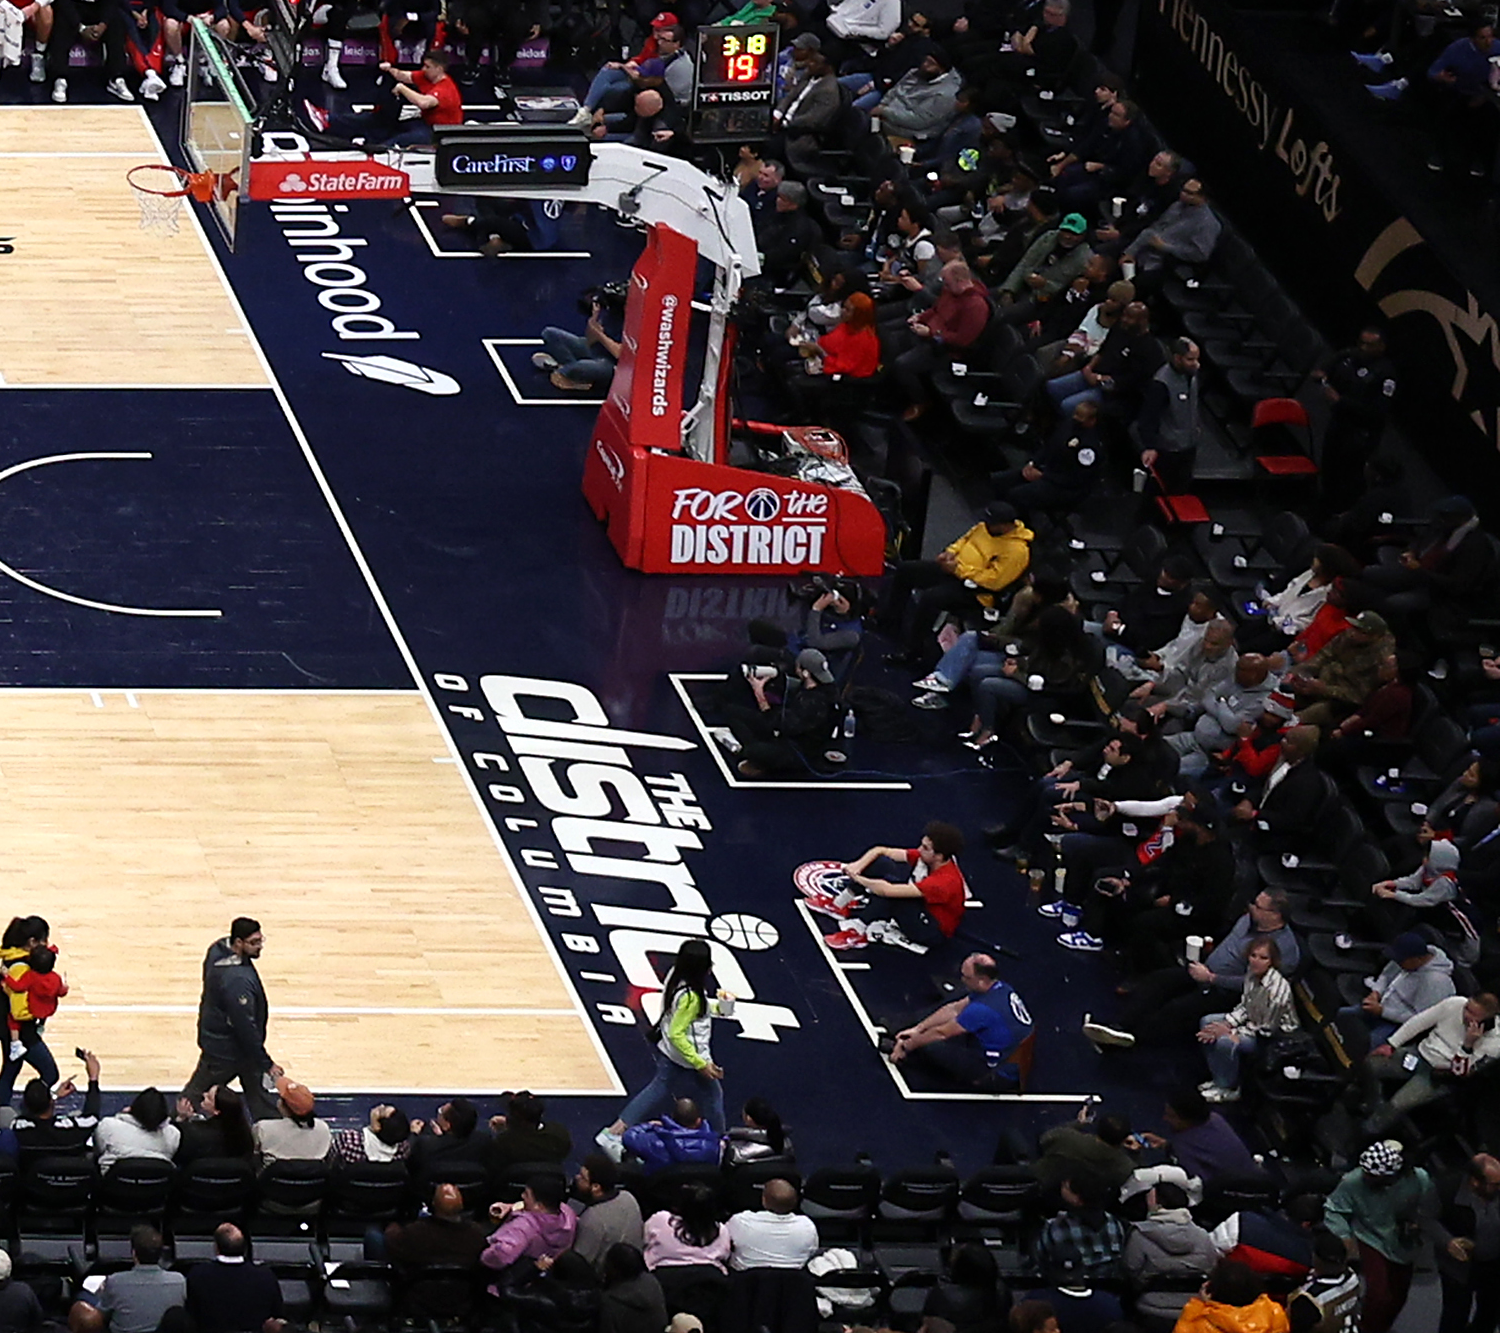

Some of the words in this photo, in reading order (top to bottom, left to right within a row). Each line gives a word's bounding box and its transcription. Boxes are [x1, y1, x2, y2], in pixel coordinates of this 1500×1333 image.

[723, 34, 766, 55] 3:18
[728, 55, 754, 80] 19
[719, 90, 770, 102] TISSOT
[452, 155, 534, 174] CareFirst
[1275, 108, 1342, 223] Lofts
[653, 294, 678, 416] @washwizards
[672, 488, 744, 521] FOR
[670, 525, 826, 564] DISTRICT
[434, 673, 484, 721] OF
[646, 772, 712, 831] THE
